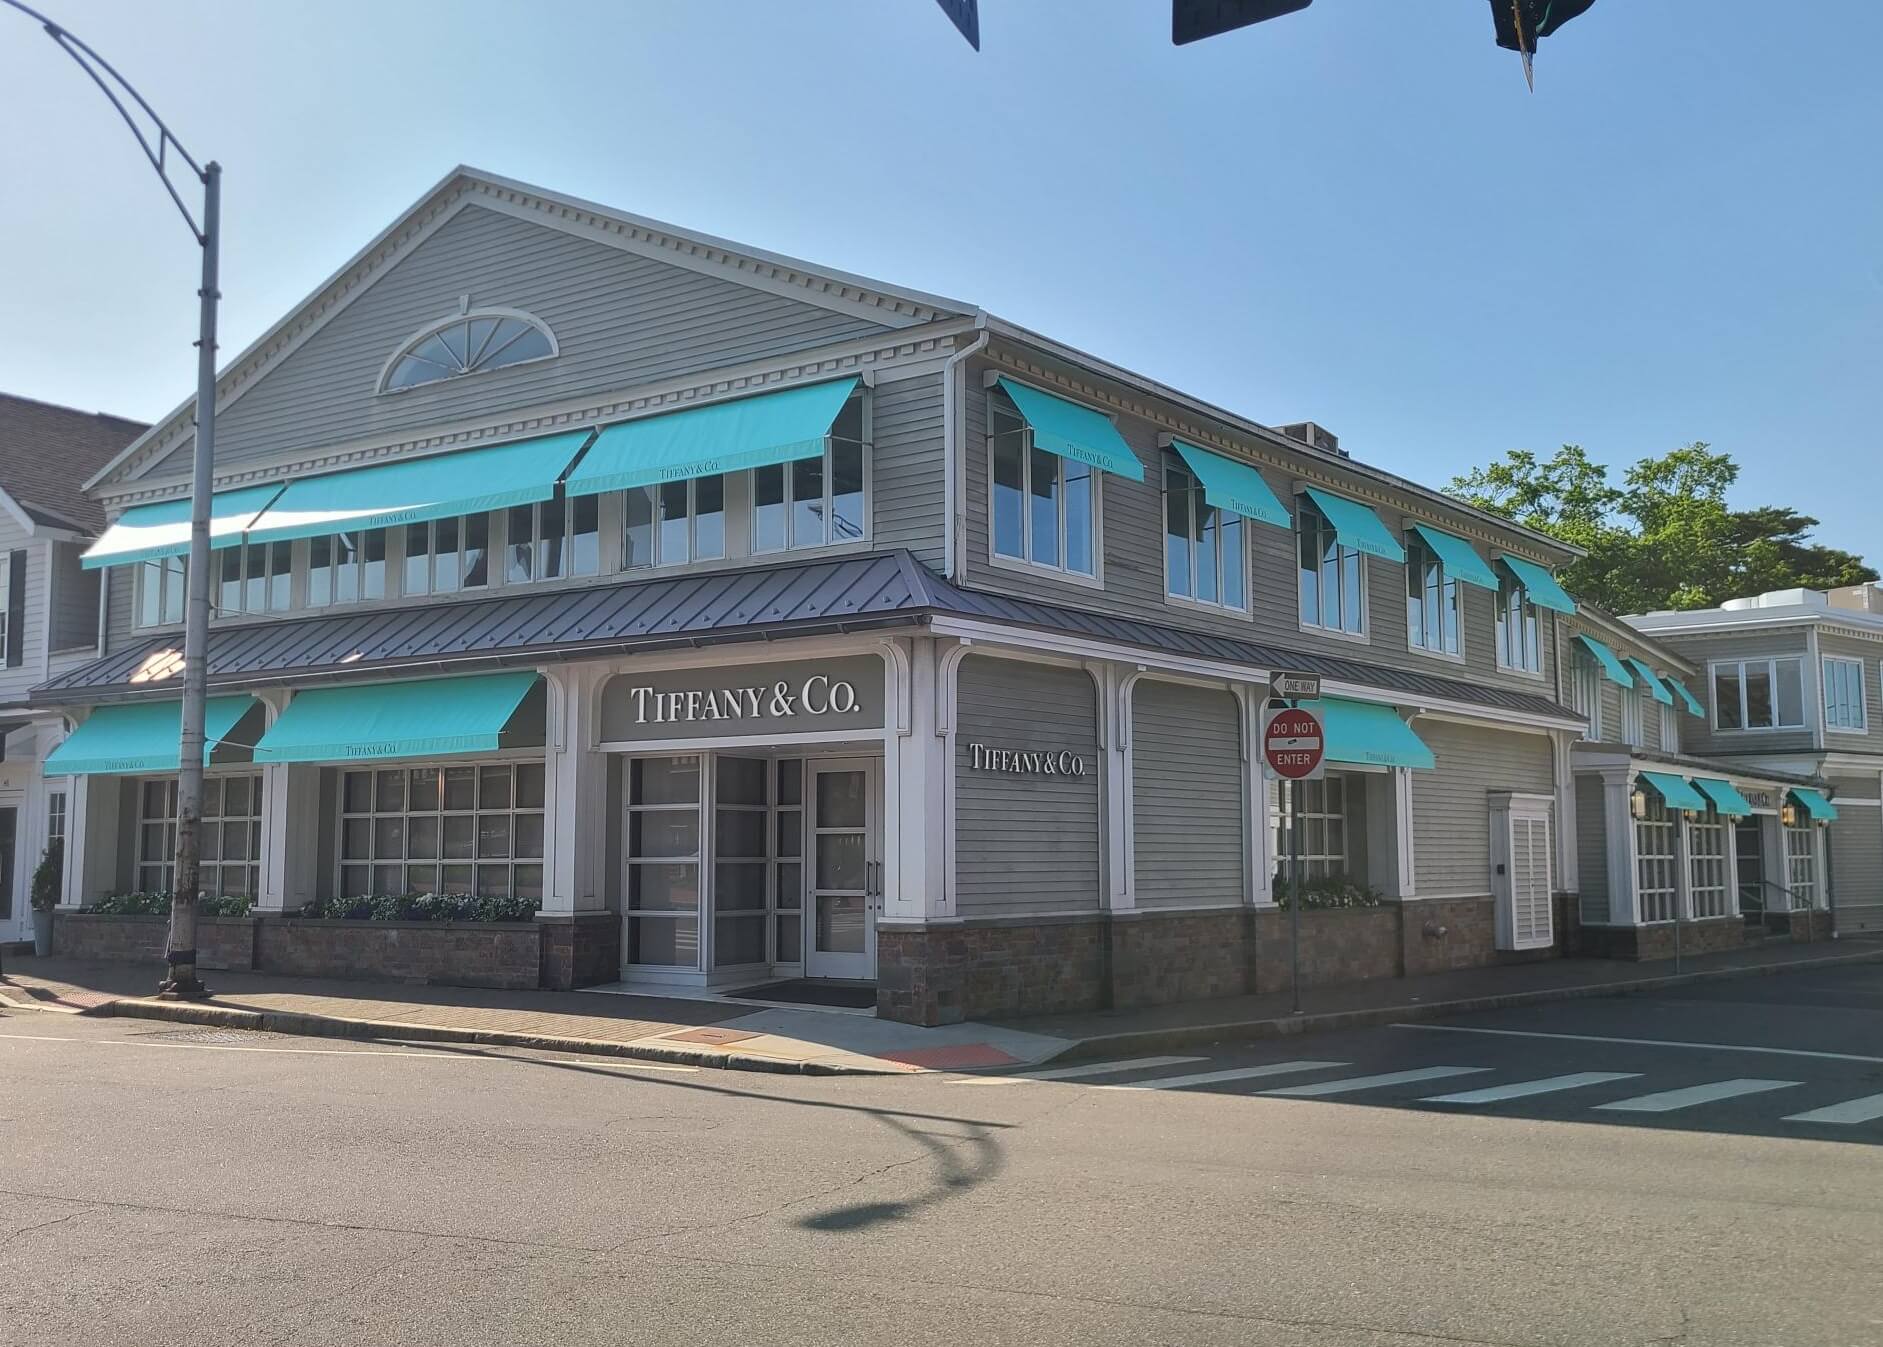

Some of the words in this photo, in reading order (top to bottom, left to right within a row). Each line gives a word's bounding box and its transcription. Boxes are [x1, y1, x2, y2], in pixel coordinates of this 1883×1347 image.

[1284, 680, 1299, 692] ONE
[1300, 680, 1316, 693] WAY
[1273, 723, 1288, 734] DO
[1294, 722, 1315, 734] NOT
[1277, 753, 1311, 766] ENTER
